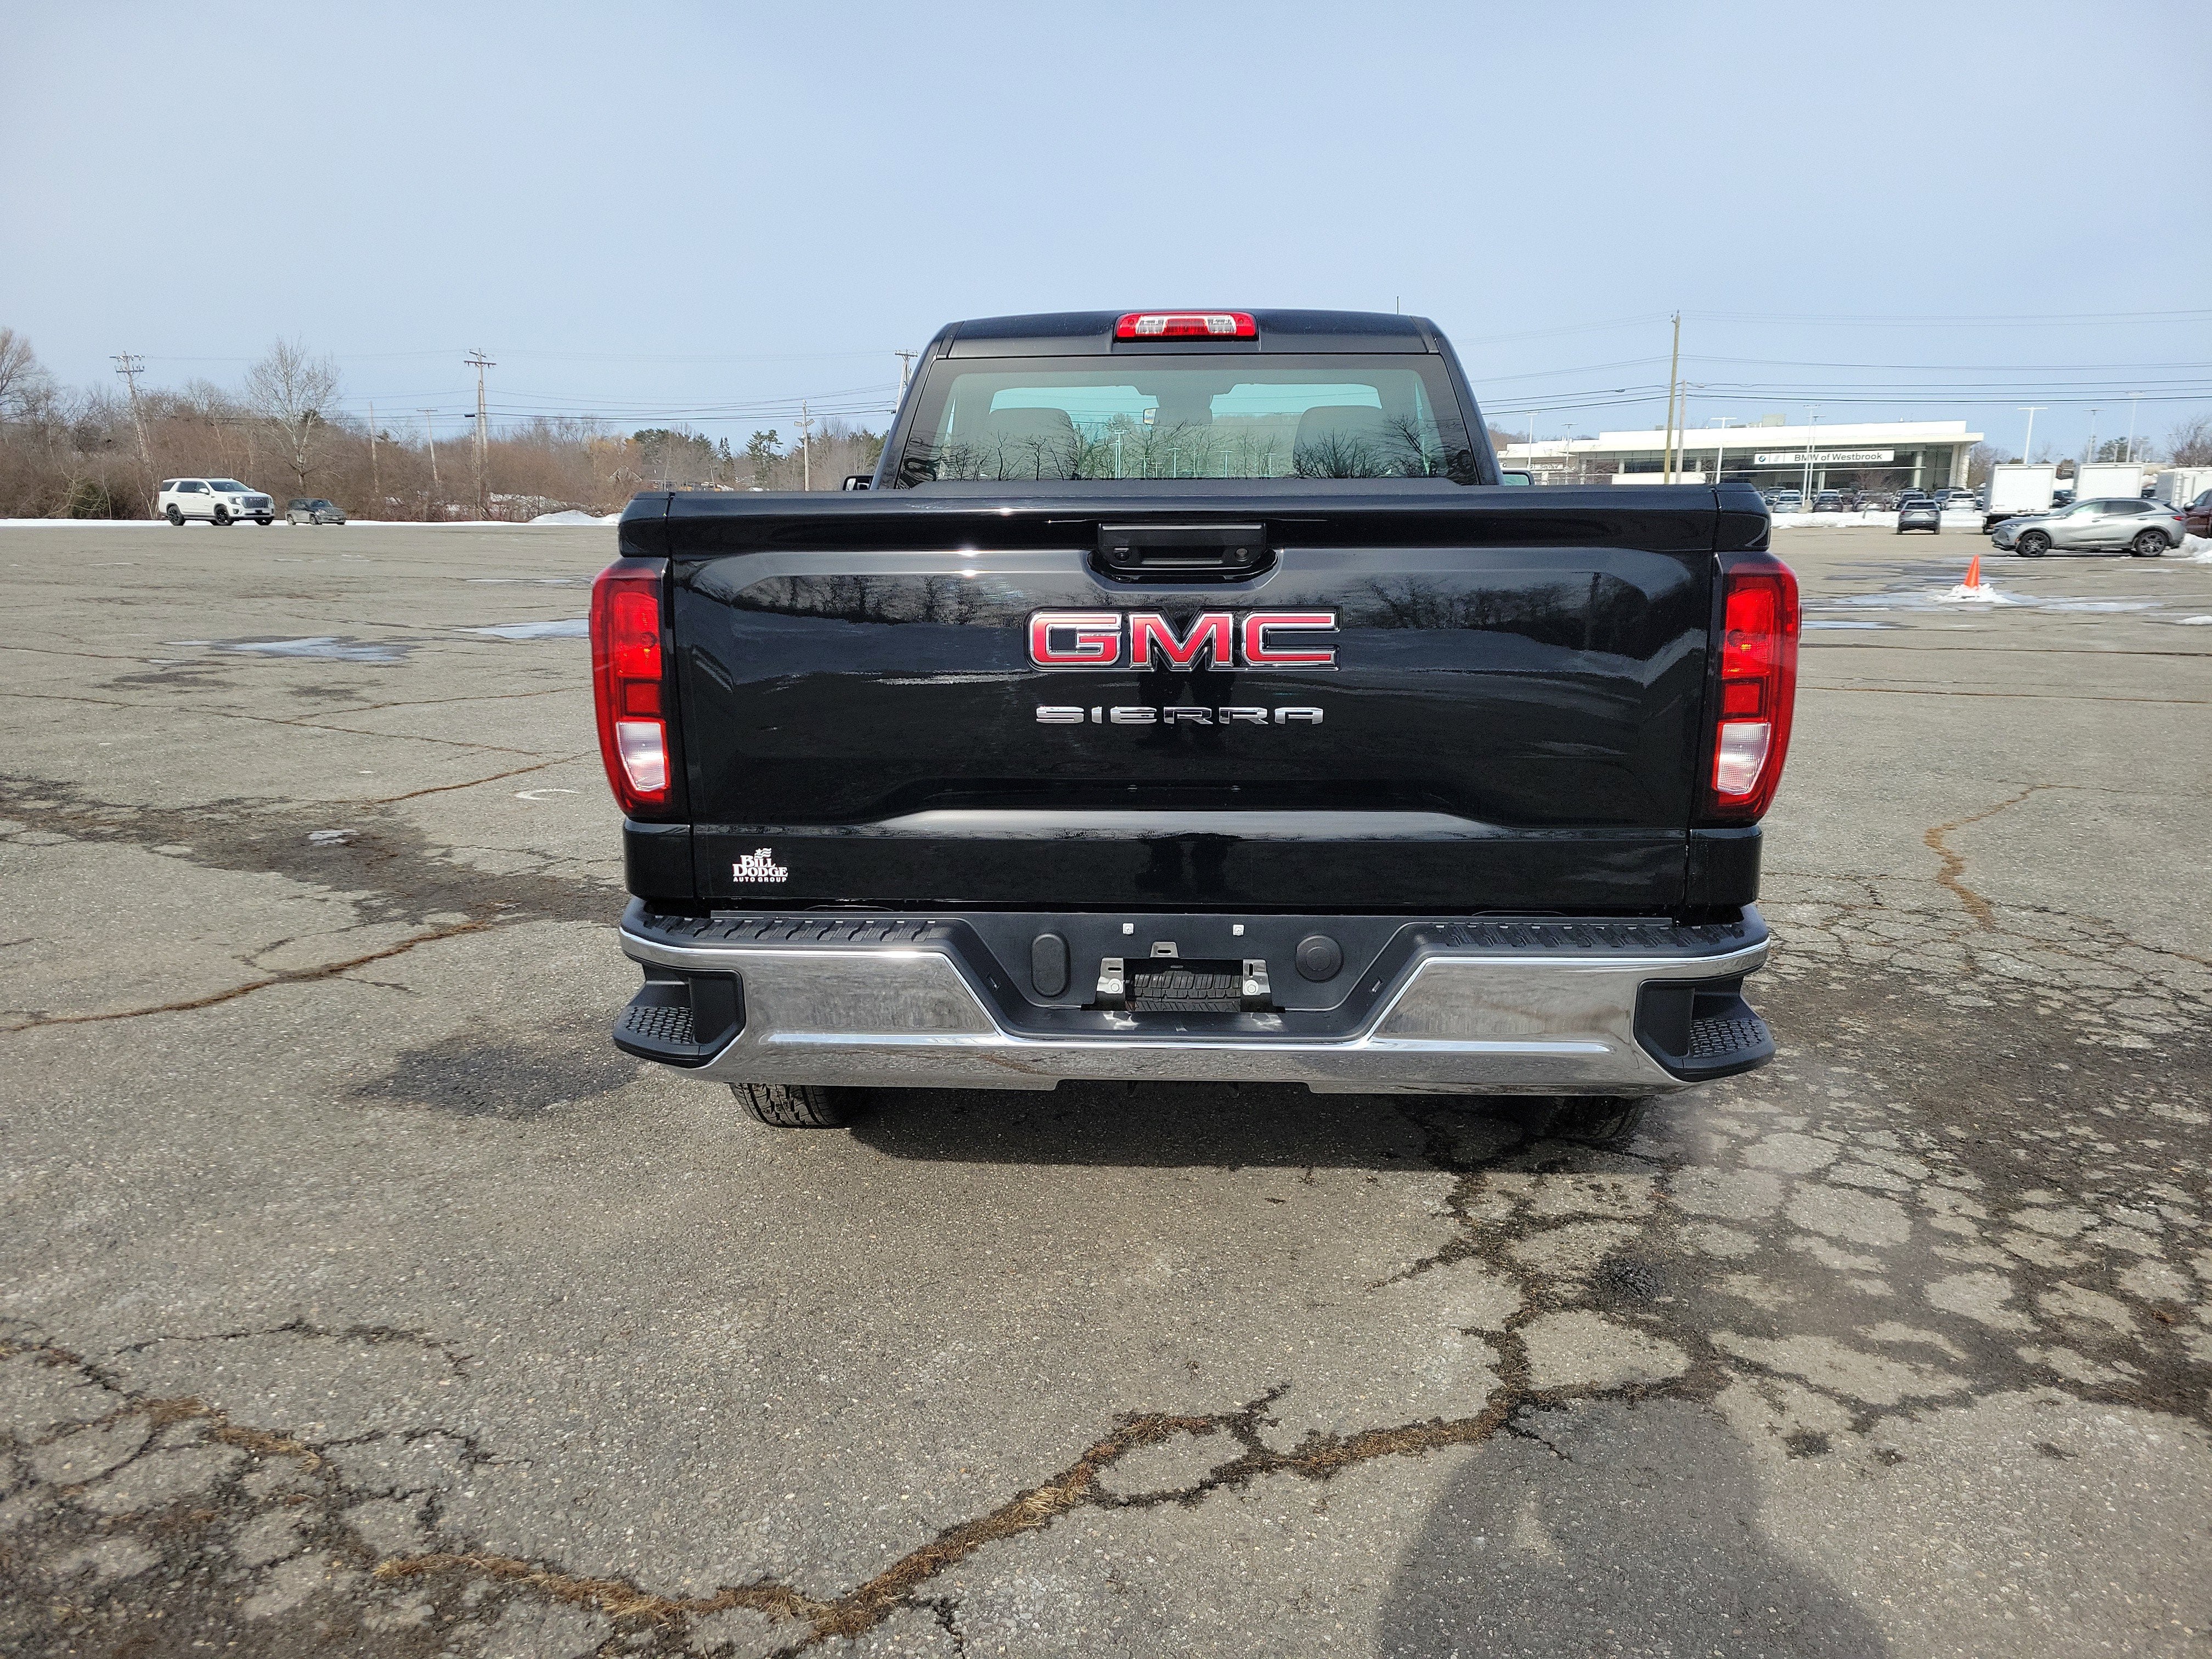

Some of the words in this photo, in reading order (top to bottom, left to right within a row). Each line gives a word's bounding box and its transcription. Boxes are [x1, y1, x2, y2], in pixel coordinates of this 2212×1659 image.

[1030, 611, 1340, 672] GMC
[1036, 706, 1323, 725] SIERRA
[740, 855, 776, 867] BILL
[732, 864, 788, 877] DODGE
